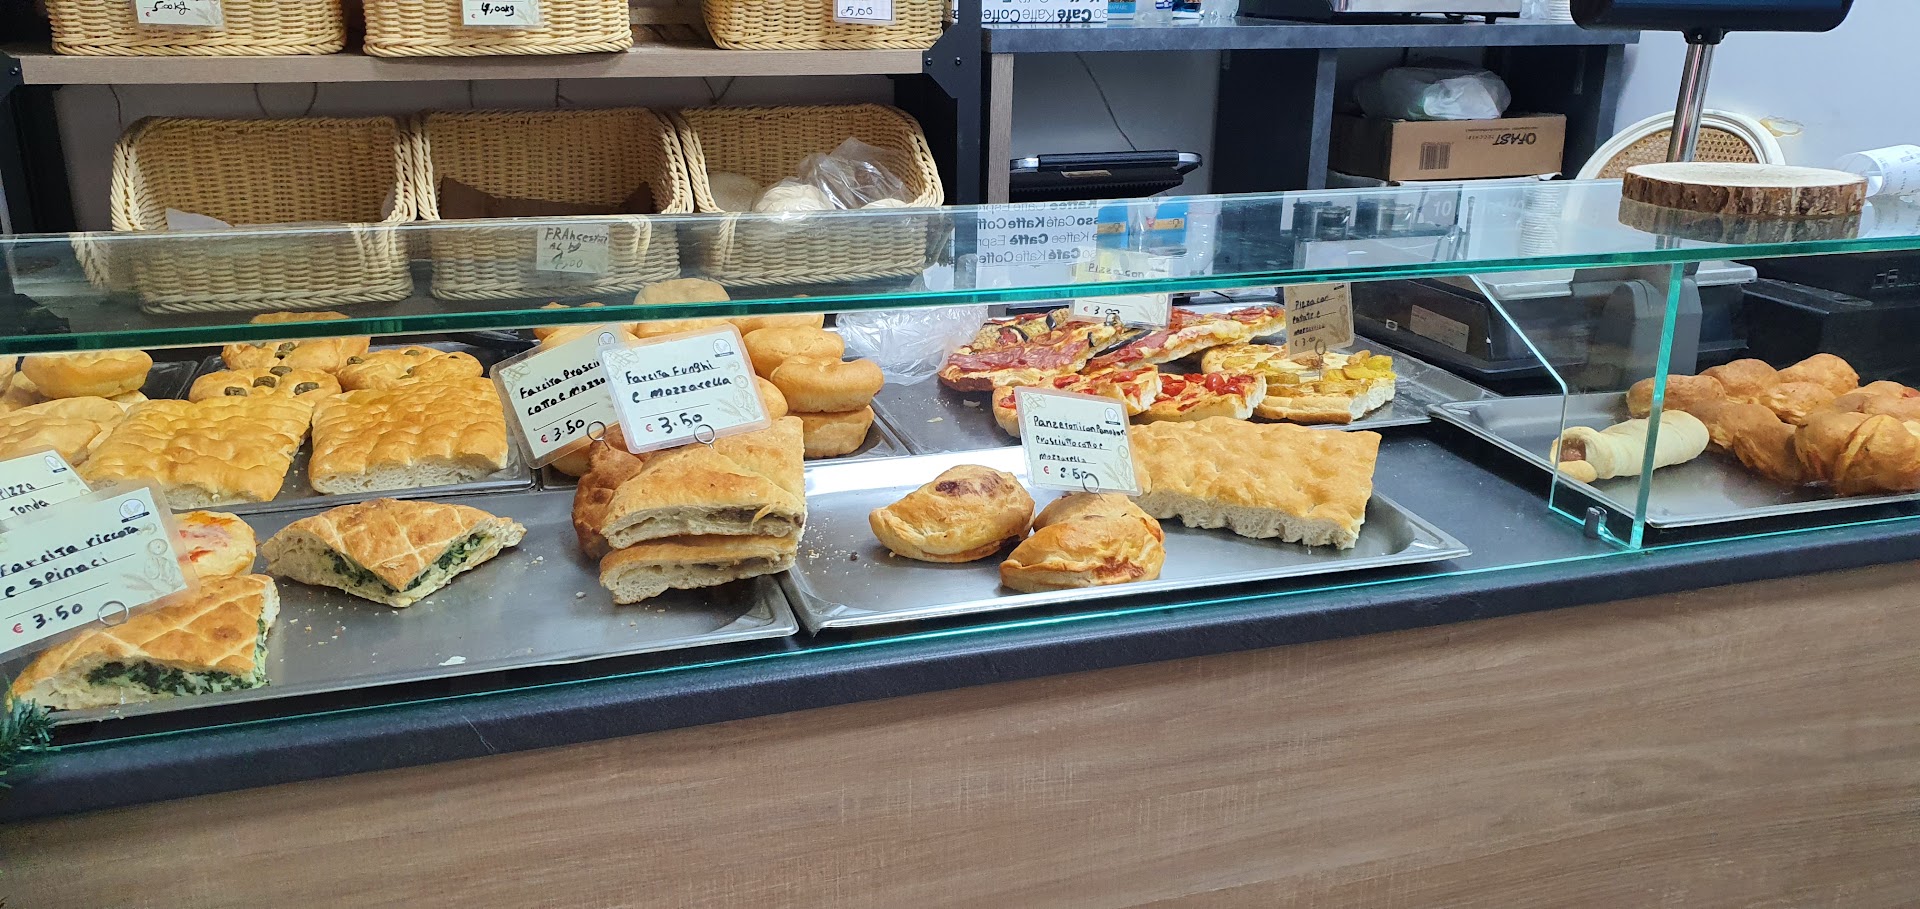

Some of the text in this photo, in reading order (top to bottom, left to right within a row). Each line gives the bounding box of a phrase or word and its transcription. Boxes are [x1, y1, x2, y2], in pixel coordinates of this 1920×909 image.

[1057, 9, 1092, 22] Café
[625, 360, 714, 385] Farcita Funghi
[632, 376, 732, 403] e mozzarella
[541, 419, 585, 443] € 3.50
[646, 412, 703, 434] € 3.50
[1043, 465, 1049, 474] €
[12, 603, 83, 633] € 3.50
